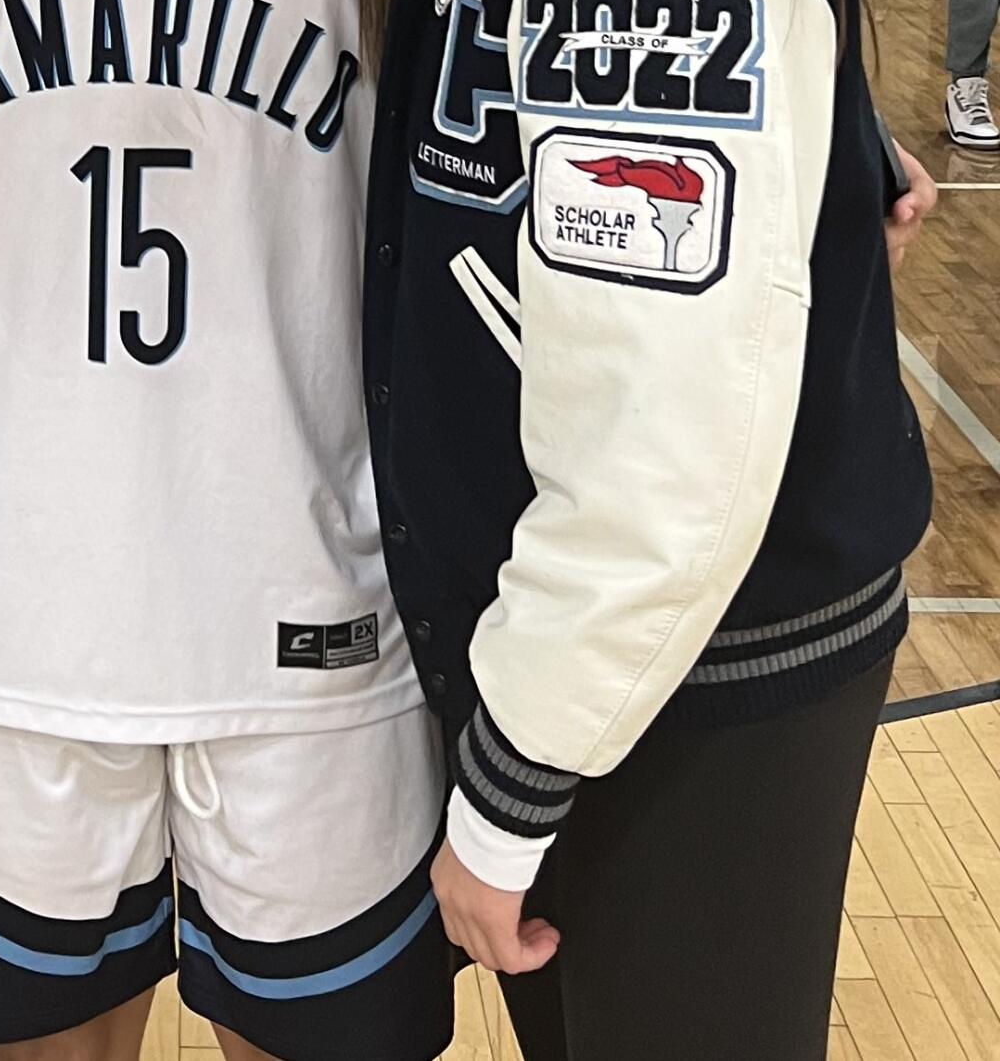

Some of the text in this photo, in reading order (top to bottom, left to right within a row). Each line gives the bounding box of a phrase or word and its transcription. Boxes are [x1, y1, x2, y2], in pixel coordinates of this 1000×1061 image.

[601, 34, 669, 49] CLASS OF
[418, 141, 496, 186] LETTERMAN
[554, 204, 636, 231] SCHOLAR
[555, 224, 629, 250] ATHLETE
[70, 145, 194, 366] 15
[354, 621, 374, 640] 2X
